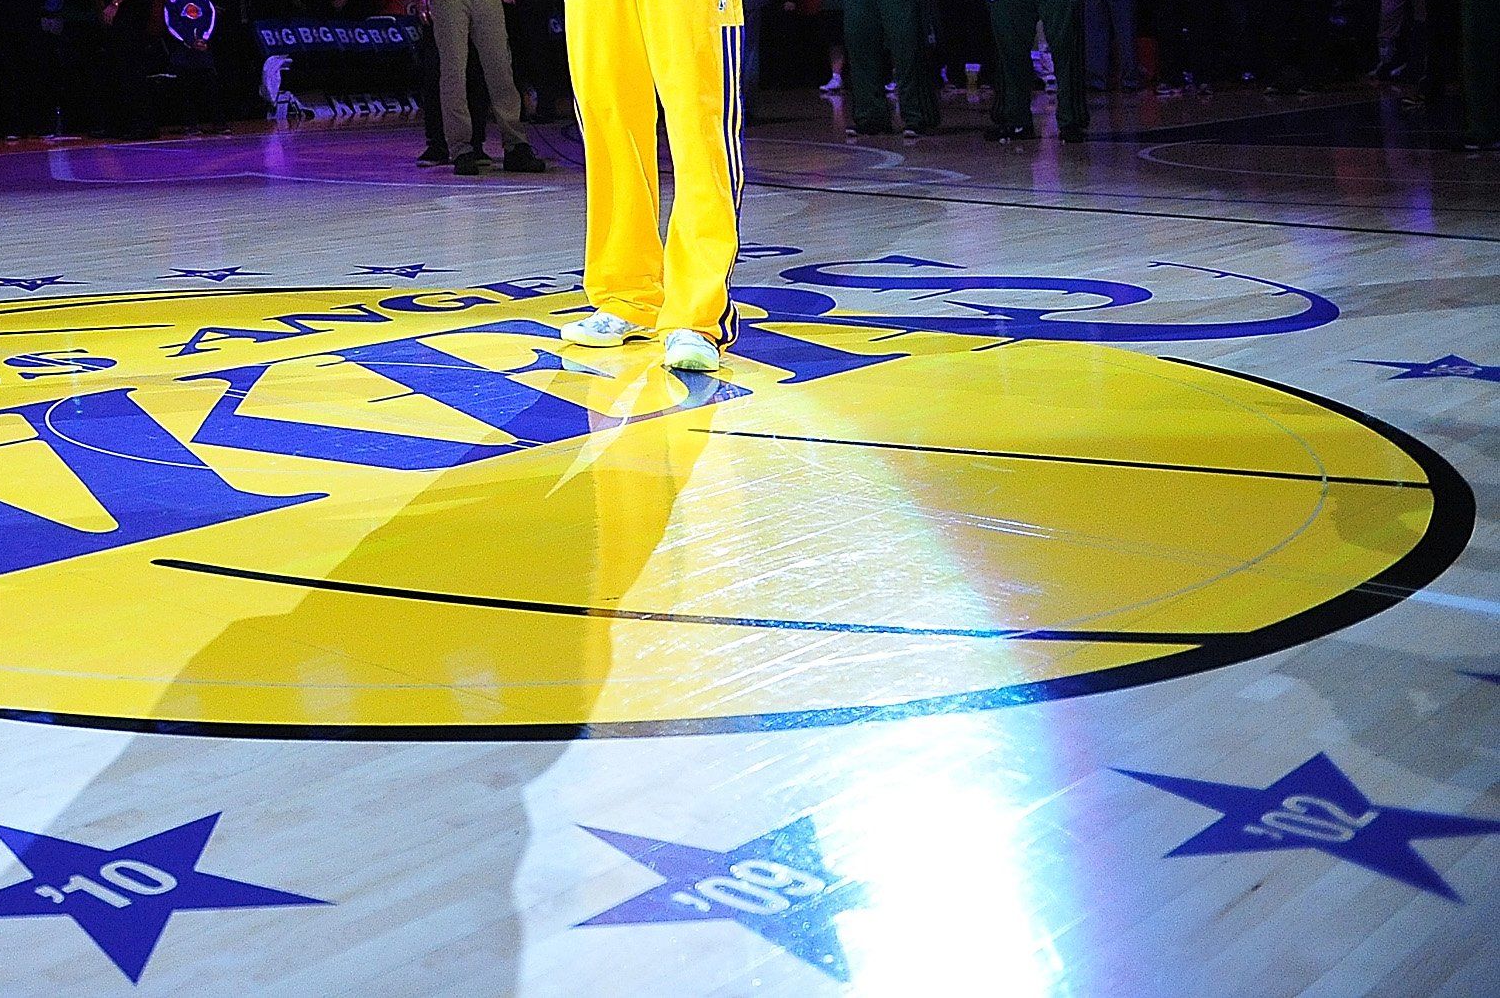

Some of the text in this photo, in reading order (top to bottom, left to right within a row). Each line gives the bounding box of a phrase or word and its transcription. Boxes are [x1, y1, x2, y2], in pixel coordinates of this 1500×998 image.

[1242, 793, 1382, 845] '02
[34, 858, 180, 911] '10
[670, 857, 830, 918] '09
